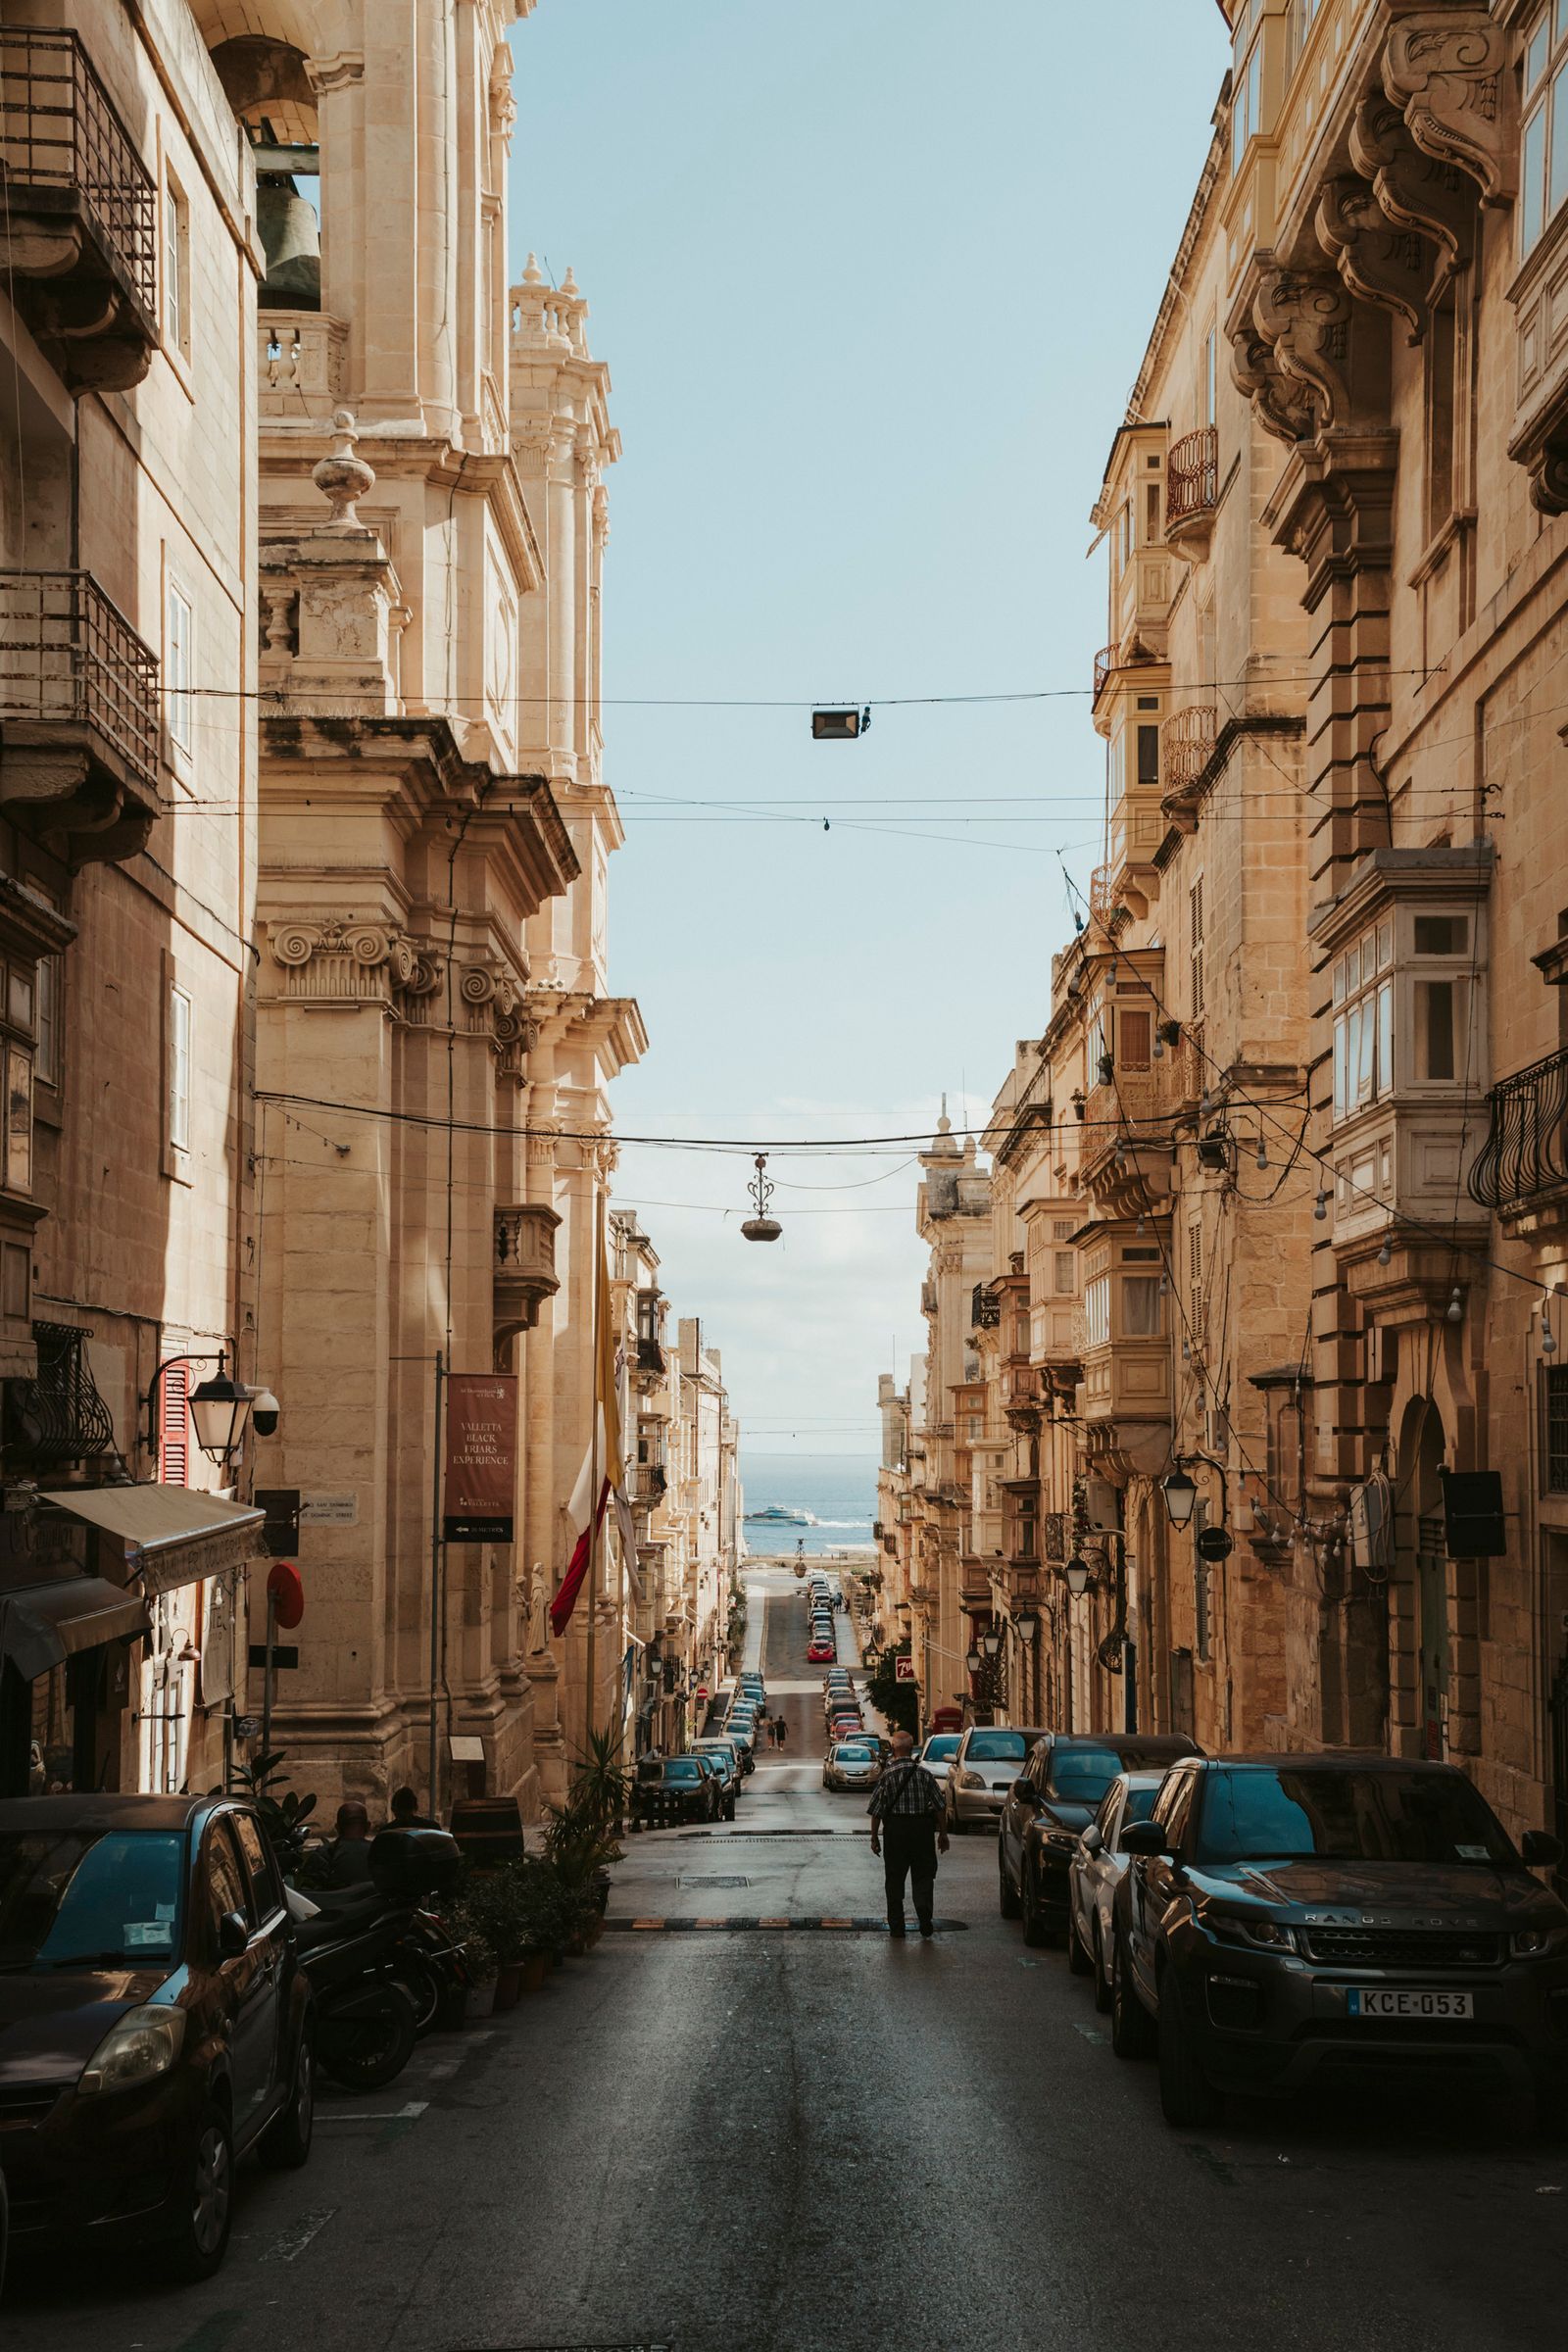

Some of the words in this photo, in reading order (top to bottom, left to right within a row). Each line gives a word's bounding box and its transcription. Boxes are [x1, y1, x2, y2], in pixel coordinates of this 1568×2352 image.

[461, 1422, 502, 1432] VALLETTA
[466, 1434, 497, 1443] BLACK
[465, 1445, 498, 1454] FRIARS
[453, 1455, 509, 1465] EXPERIENCE
[1304, 1913, 1394, 1926] RANGE
